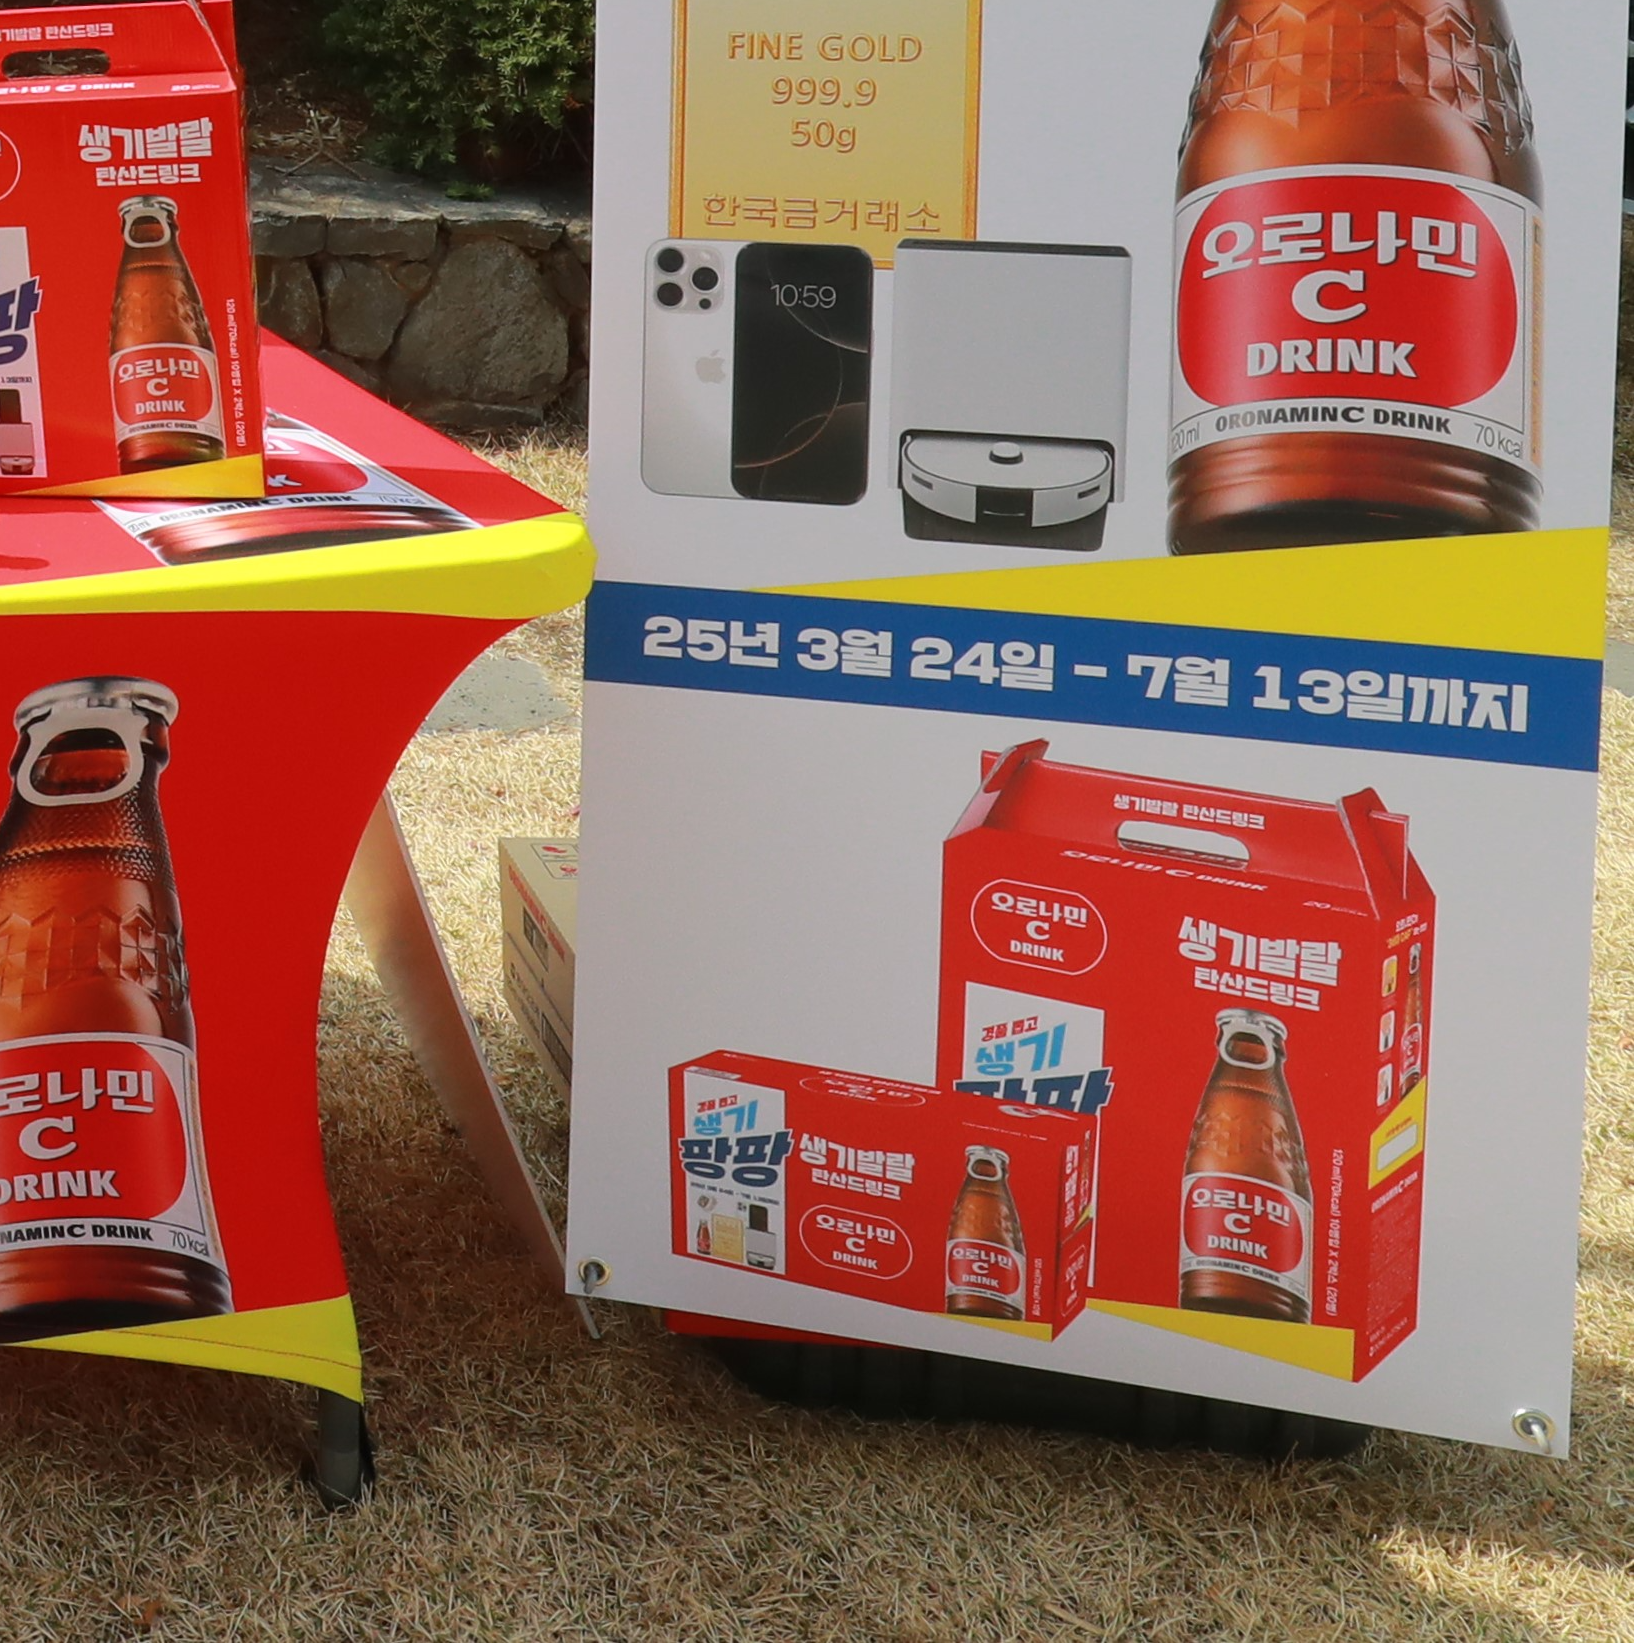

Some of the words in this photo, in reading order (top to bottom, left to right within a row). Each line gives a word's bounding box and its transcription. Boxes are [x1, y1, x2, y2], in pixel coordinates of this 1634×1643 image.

[726, 32, 805, 63] FINE
[815, 32, 924, 63] GOLD
[769, 74, 878, 108] 999.9
[78, 117, 214, 163] 생기발랄
[789, 119, 859, 154] 50g
[95, 164, 202, 187] 탄산드링크
[701, 192, 941, 235] 한국금거래소
[1199, 210, 1479, 283] 오로나민
[770, 282, 837, 311] 10:59
[1291, 270, 1369, 325] C
[1245, 338, 1418, 379] DRINK
[1373, 409, 1452, 435] DRINK
[642, 613, 780, 667] 25년
[796, 624, 893, 678] 3월
[910, 637, 1056, 693] 24일
[1126, 654, 1230, 710] 7월
[1253, 663, 1529, 734] 13일까지
[1114, 794, 1179, 819] 생기발랄
[1183, 804, 1265, 830] 탄산드링크
[992, 891, 1088, 928] 오로나민
[1026, 921, 1050, 941] C
[1010, 940, 1064, 963] DRINK
[1179, 915, 1342, 986] 생기발랄
[1194, 967, 1321, 1012] 탄산드링크
[975, 1022, 1067, 1076] 생기
[19, 1116, 76, 1160] C
[799, 1134, 915, 1184] 생기발랄
[811, 1168, 901, 1201] 탄산드링크
[1192, 1187, 1291, 1227] 오로나민
[1224, 1214, 1251, 1235] C
[92, 1224, 154, 1241] DRINK
[1208, 1234, 1268, 1259] DRINK
